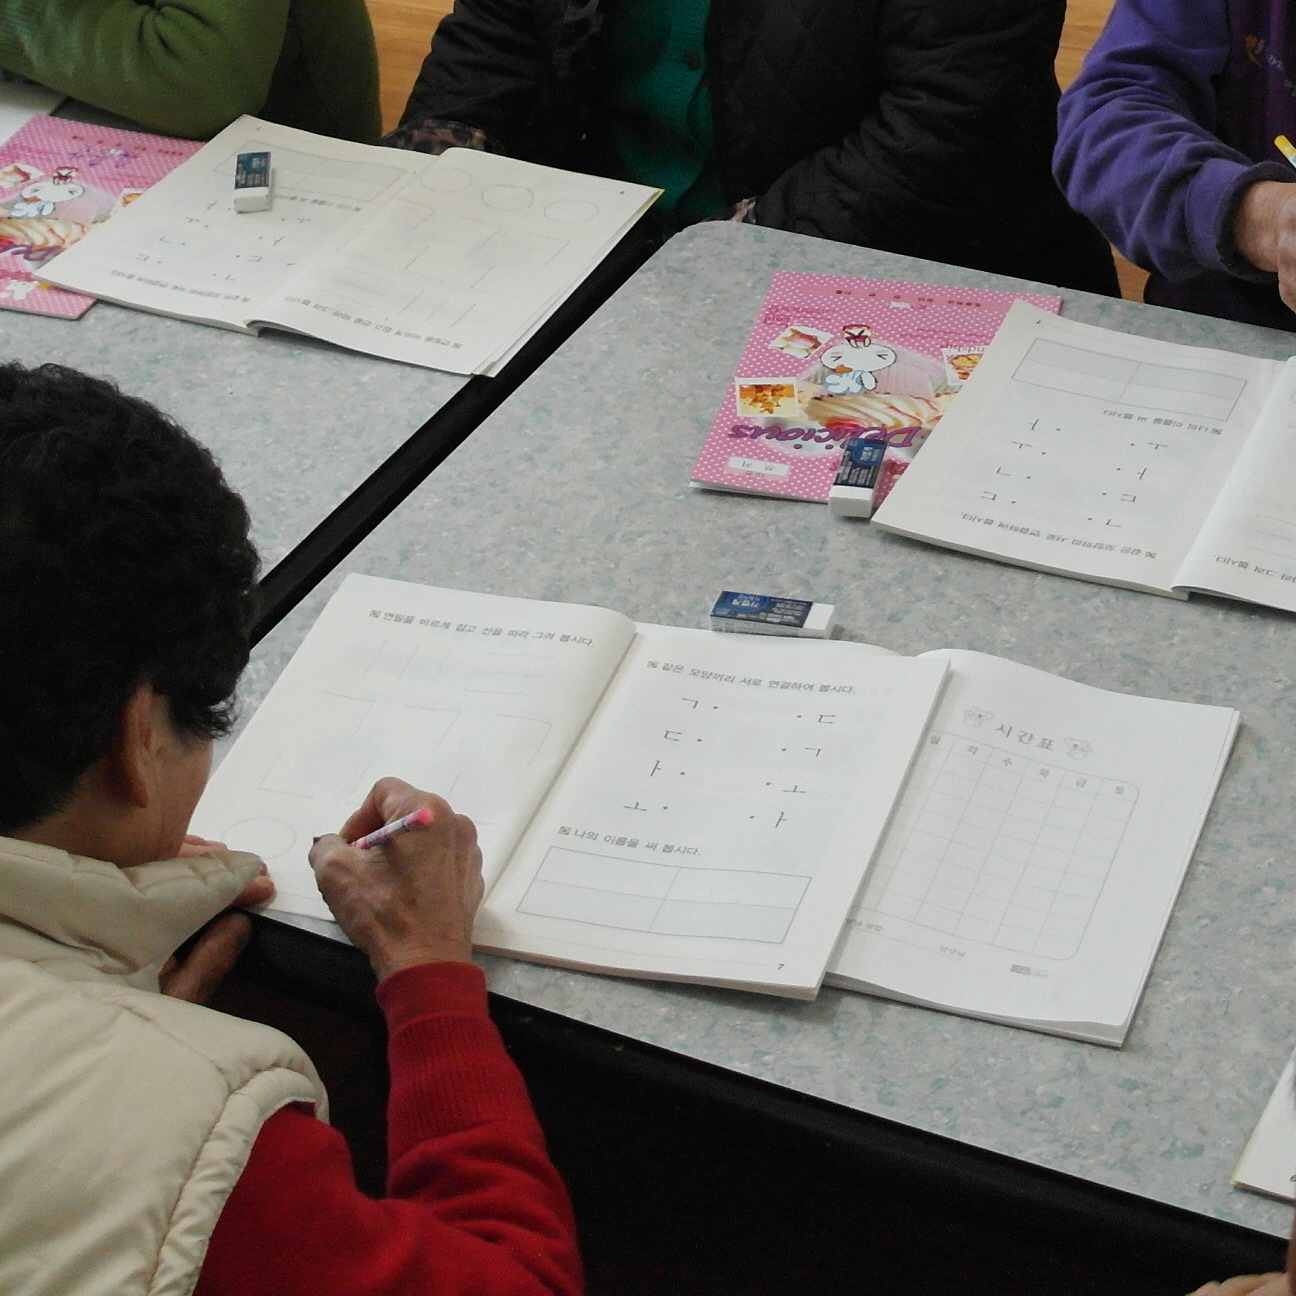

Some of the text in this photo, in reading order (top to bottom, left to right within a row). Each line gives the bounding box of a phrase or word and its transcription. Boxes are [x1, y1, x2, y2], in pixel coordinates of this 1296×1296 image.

[662, 661, 856, 695] 같은 모양끼리 서로 연결하여 봅시다.
[995, 724, 1054, 751] 시간표
[574, 829, 701, 856] 나의 이름을 써 봅시다.
[777, 963, 785, 971] 7
